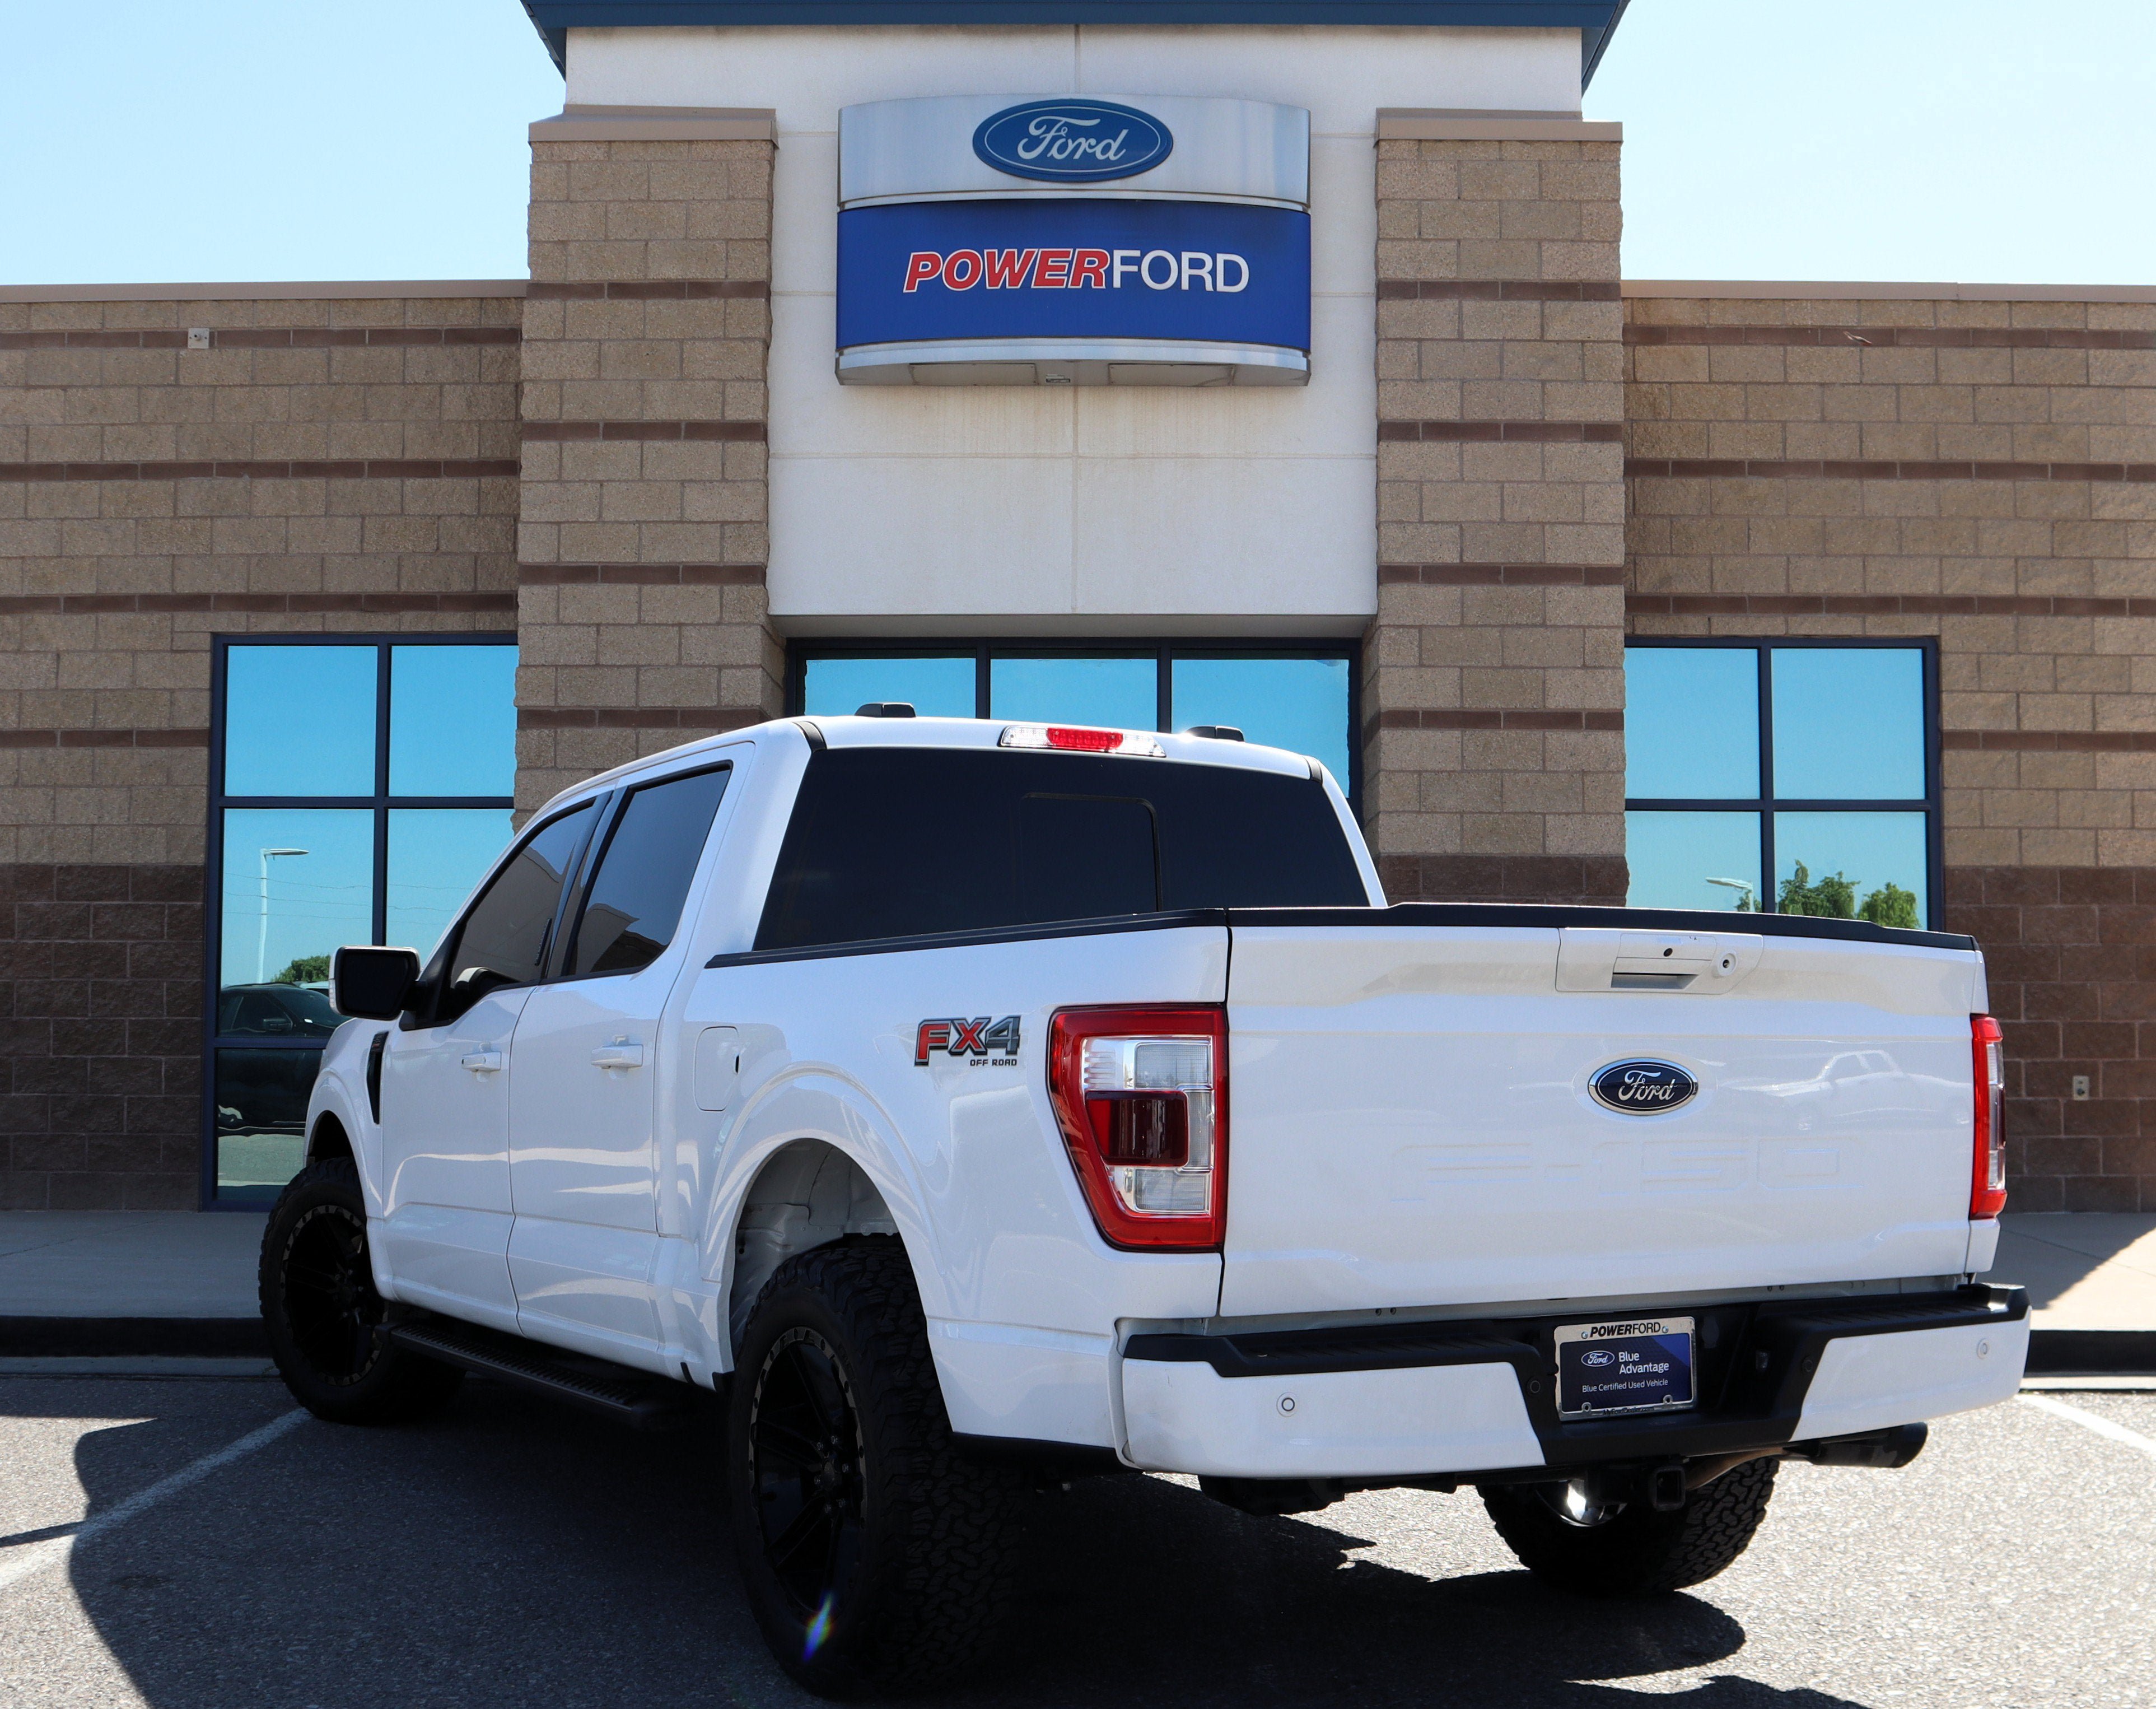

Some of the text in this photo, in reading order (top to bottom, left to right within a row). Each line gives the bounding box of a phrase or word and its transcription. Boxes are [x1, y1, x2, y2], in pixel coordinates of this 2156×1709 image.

[1018, 115, 1126, 161] Ford
[903, 248, 1249, 293] POWERFORD
[914, 1015, 1021, 1067] FX4
[1618, 1070, 1676, 1101] Ford
[1390, 1135, 1865, 1203] F-150
[1590, 1322, 1661, 1338] POWERFORD
[1588, 1353, 1608, 1363] Ford
[1618, 1352, 1640, 1362] Blue
[1619, 1362, 1669, 1375] Advantage
[1598, 1381, 1627, 1391] Certified
[1628, 1380, 1645, 1389] Used
[1646, 1378, 1669, 1387] Vehicle
